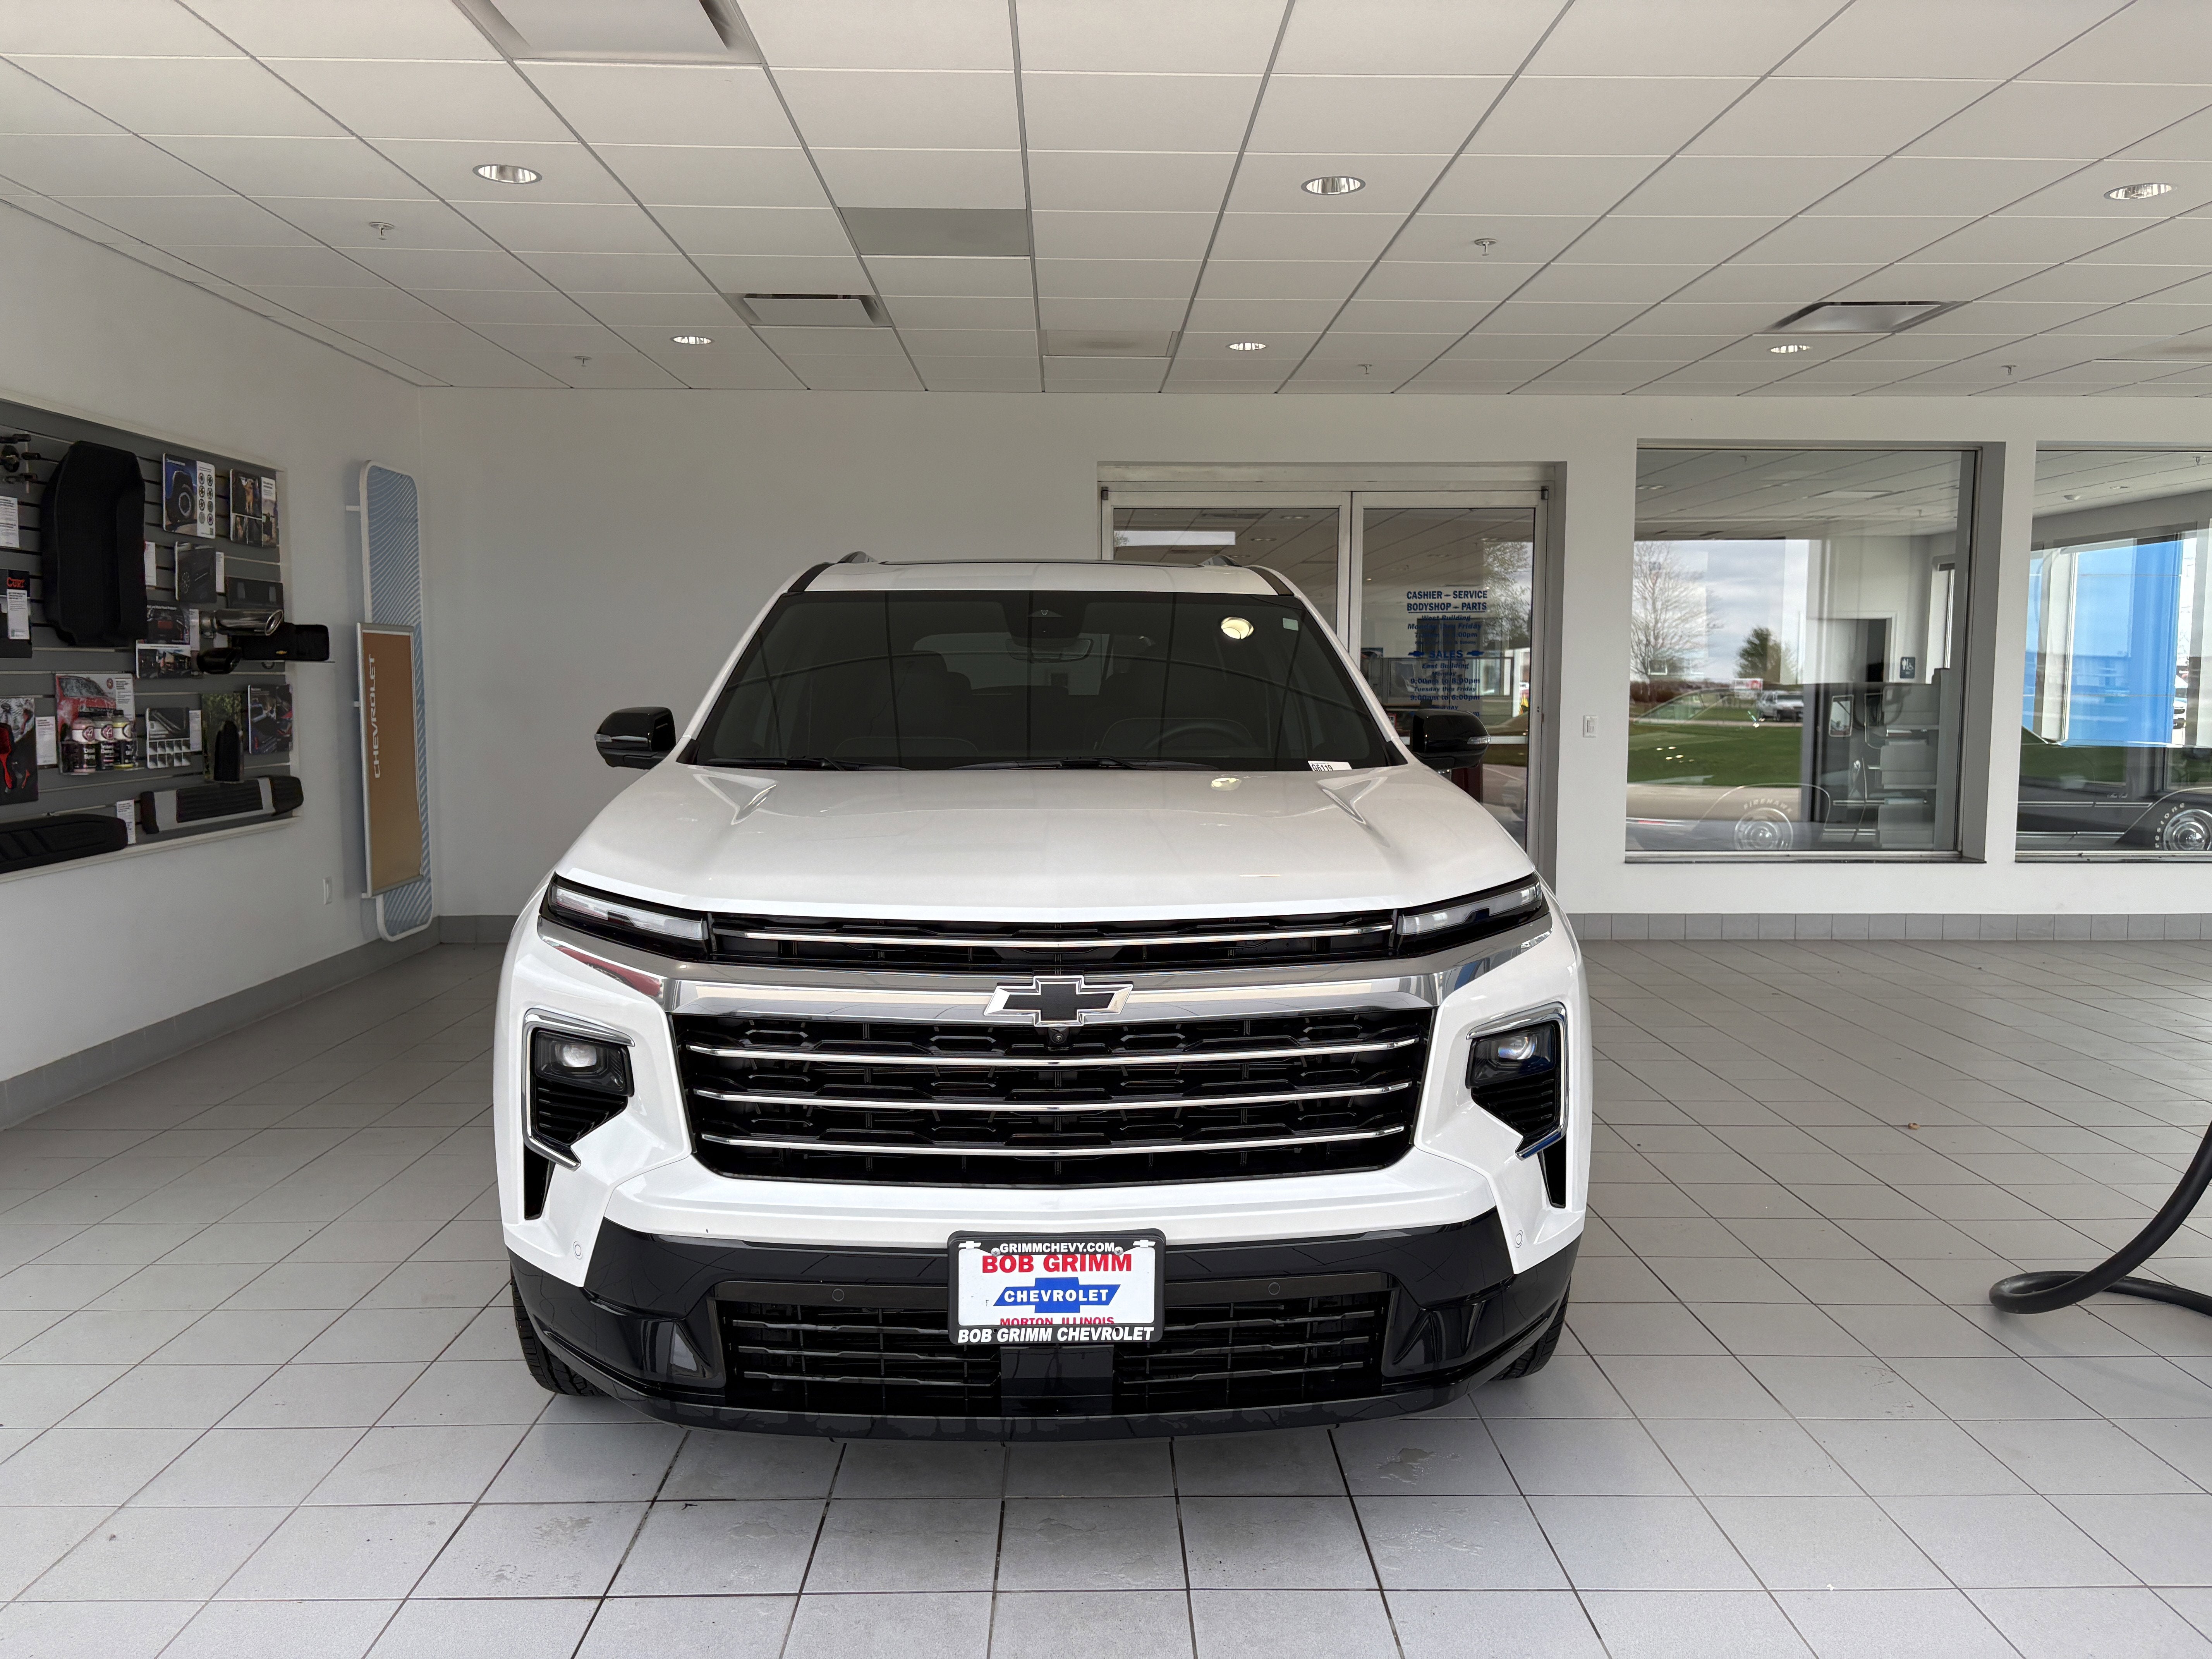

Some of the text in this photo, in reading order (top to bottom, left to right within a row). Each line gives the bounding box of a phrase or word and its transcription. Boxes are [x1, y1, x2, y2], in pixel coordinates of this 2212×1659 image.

[1407, 590, 1487, 599] CASHIER SERVICE
[1407, 602, 1487, 611] BODYSHOP PARTS
[1429, 650, 1463, 658] SALES
[369, 654, 380, 778] CHEVROLET
[2155, 803, 2185, 848] restone
[1000, 1242, 1115, 1253] GRIMMCHEVY.COM
[982, 1254, 1132, 1273] BOB GRIMM
[1004, 1289, 1109, 1302] CHEVROLET
[1000, 1317, 1115, 1326] MORTON ILLINOIS
[958, 1326, 1154, 1343] BOB GRIMM CHEVROLET
